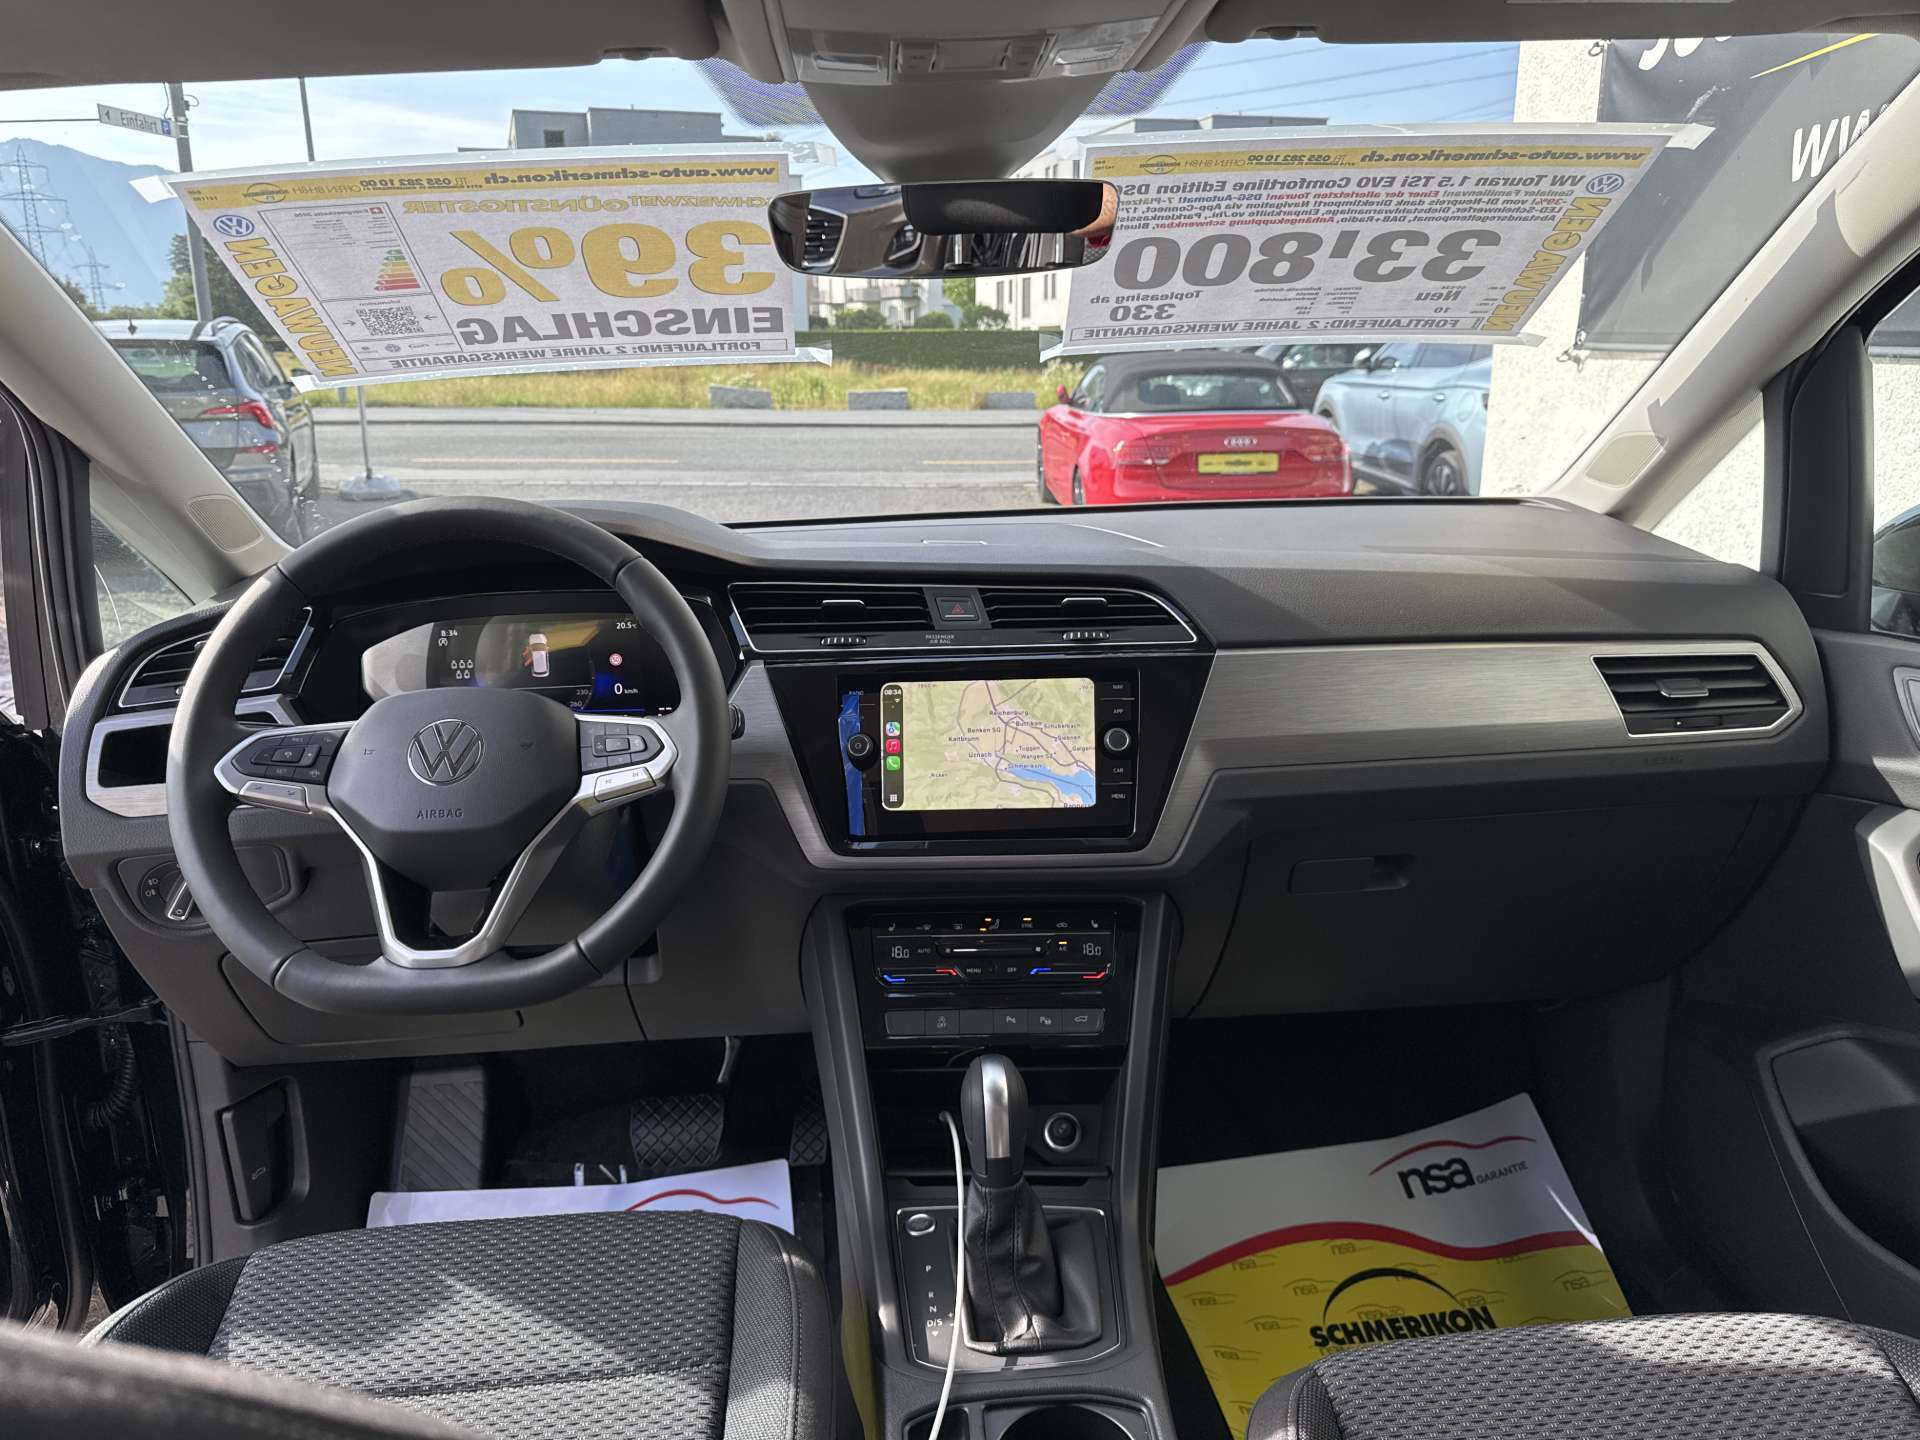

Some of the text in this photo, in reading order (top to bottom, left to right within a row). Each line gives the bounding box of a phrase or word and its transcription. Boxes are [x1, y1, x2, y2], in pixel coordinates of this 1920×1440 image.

[119, 111, 159, 133] Einfahrt
[614, 683, 624, 695] 0
[416, 808, 464, 820] AIRBAG
[966, 966, 982, 974] MENU
[1006, 966, 1017, 974] OFF
[1397, 1156, 1529, 1200] nsa GARANTIE
[926, 1318, 943, 1328] D/S
[1308, 1305, 1498, 1348] SCHMERIKON
